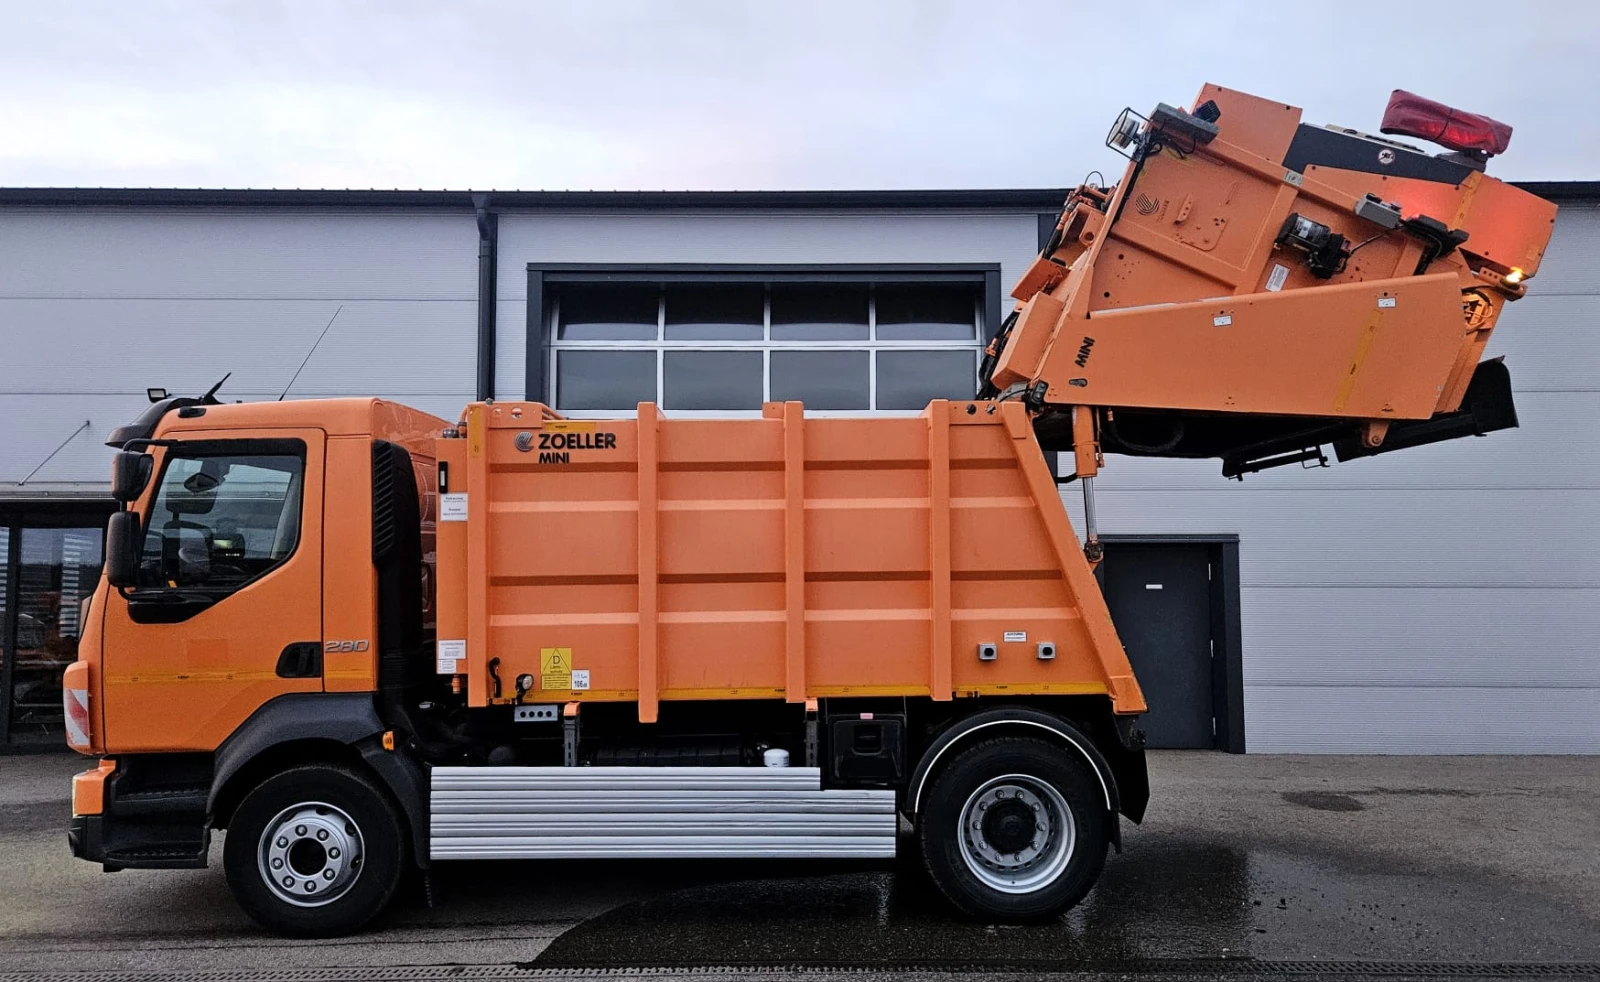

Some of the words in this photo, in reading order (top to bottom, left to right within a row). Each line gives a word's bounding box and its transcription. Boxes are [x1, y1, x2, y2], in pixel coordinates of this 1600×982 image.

[1075, 336, 1095, 368] MINI
[538, 433, 616, 449] ZOELLER
[539, 452, 570, 464] MINI
[325, 639, 369, 653] 280
[553, 655, 560, 664] D
